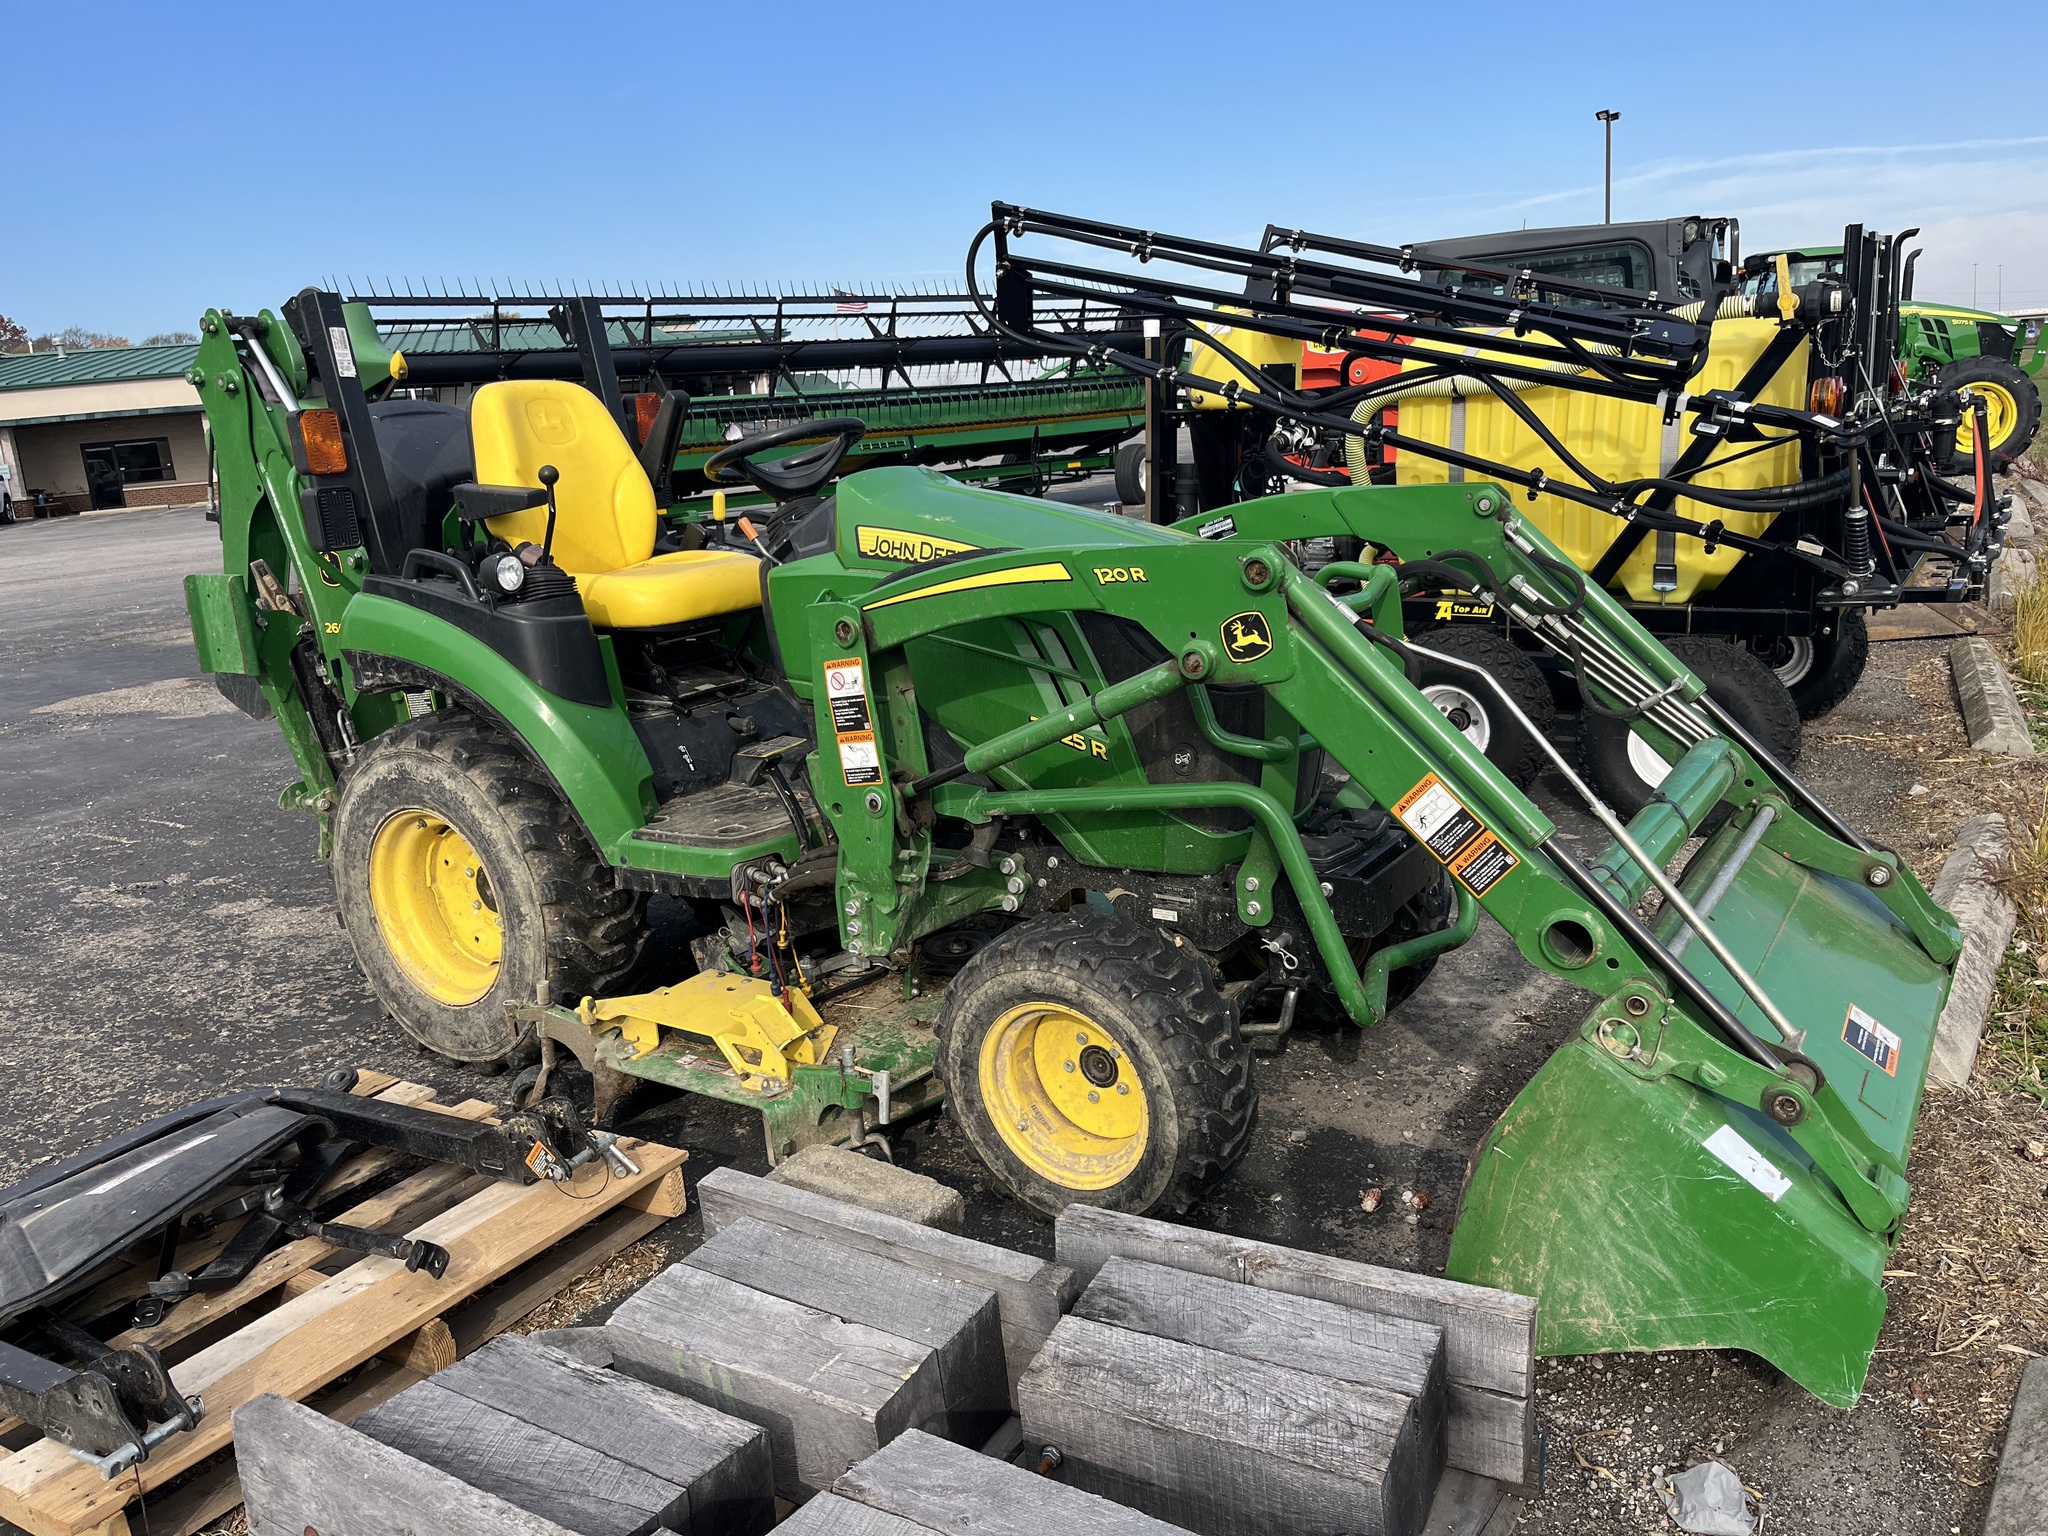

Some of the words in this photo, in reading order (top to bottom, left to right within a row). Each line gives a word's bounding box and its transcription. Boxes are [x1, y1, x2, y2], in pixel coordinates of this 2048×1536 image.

[869, 535, 915, 559] JOHN
[1092, 567, 1129, 585] 120
[1128, 567, 1149, 583] R
[324, 622, 341, 634] 26
[830, 659, 860, 668] WARNING
[844, 734, 873, 742] WARNING
[1090, 738, 1109, 762] R
[1403, 778, 1432, 806] WARNING
[1462, 836, 1491, 864] WARNING
